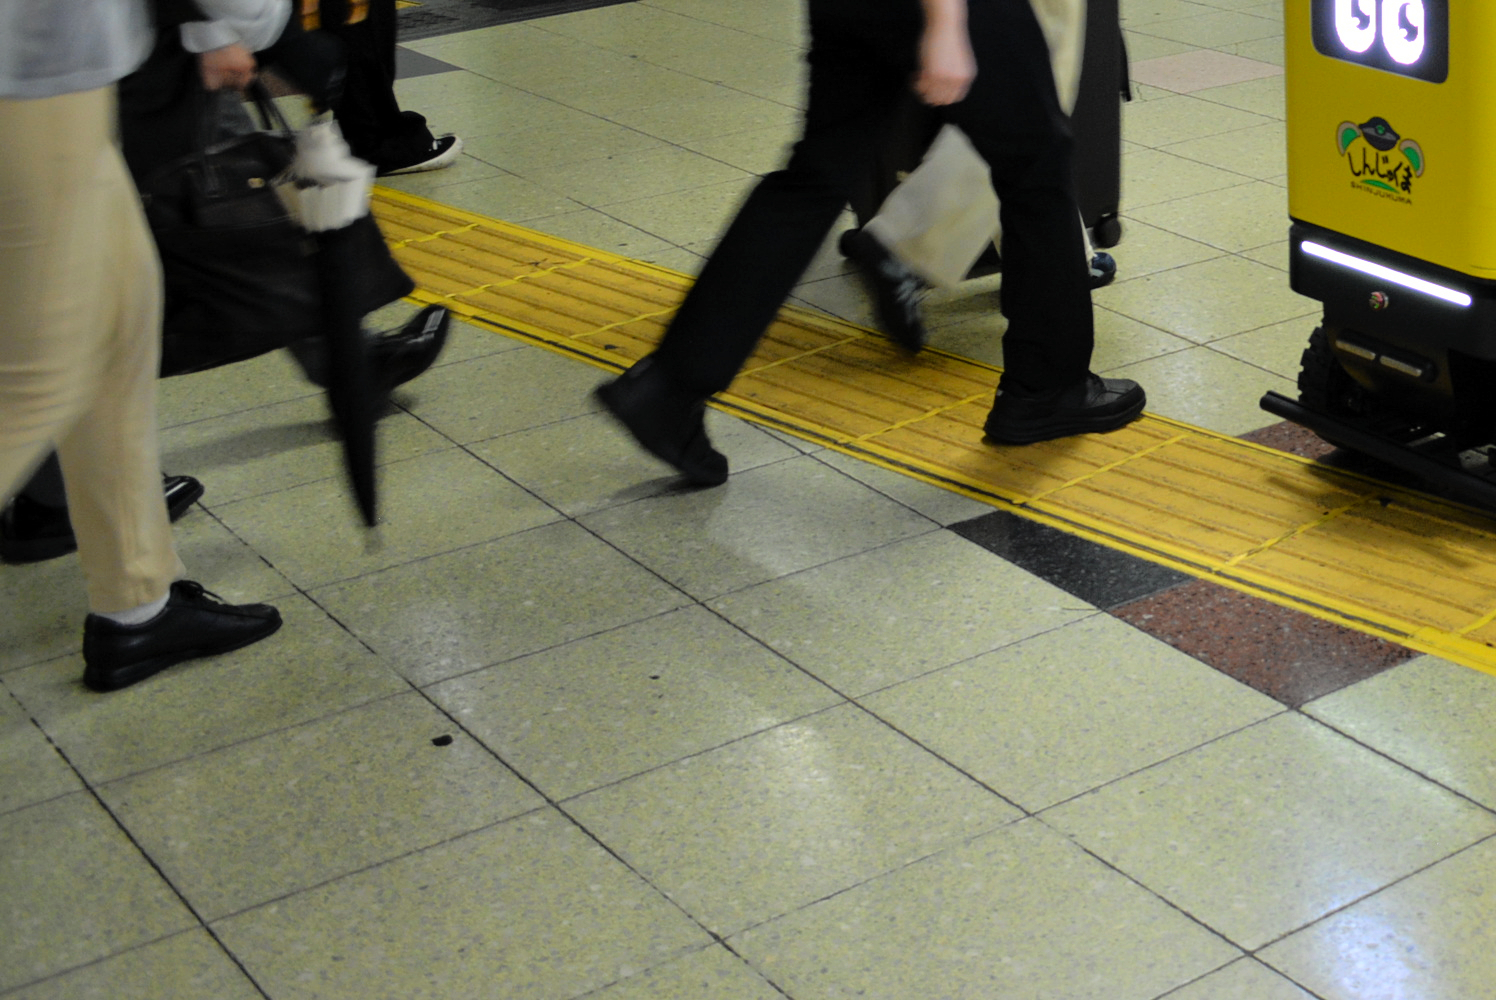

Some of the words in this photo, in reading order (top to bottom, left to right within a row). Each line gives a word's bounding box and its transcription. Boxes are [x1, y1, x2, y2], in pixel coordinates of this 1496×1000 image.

[1347, 147, 1413, 194] しんじゅくま
[1350, 181, 1412, 205] SHINJUKUMA
